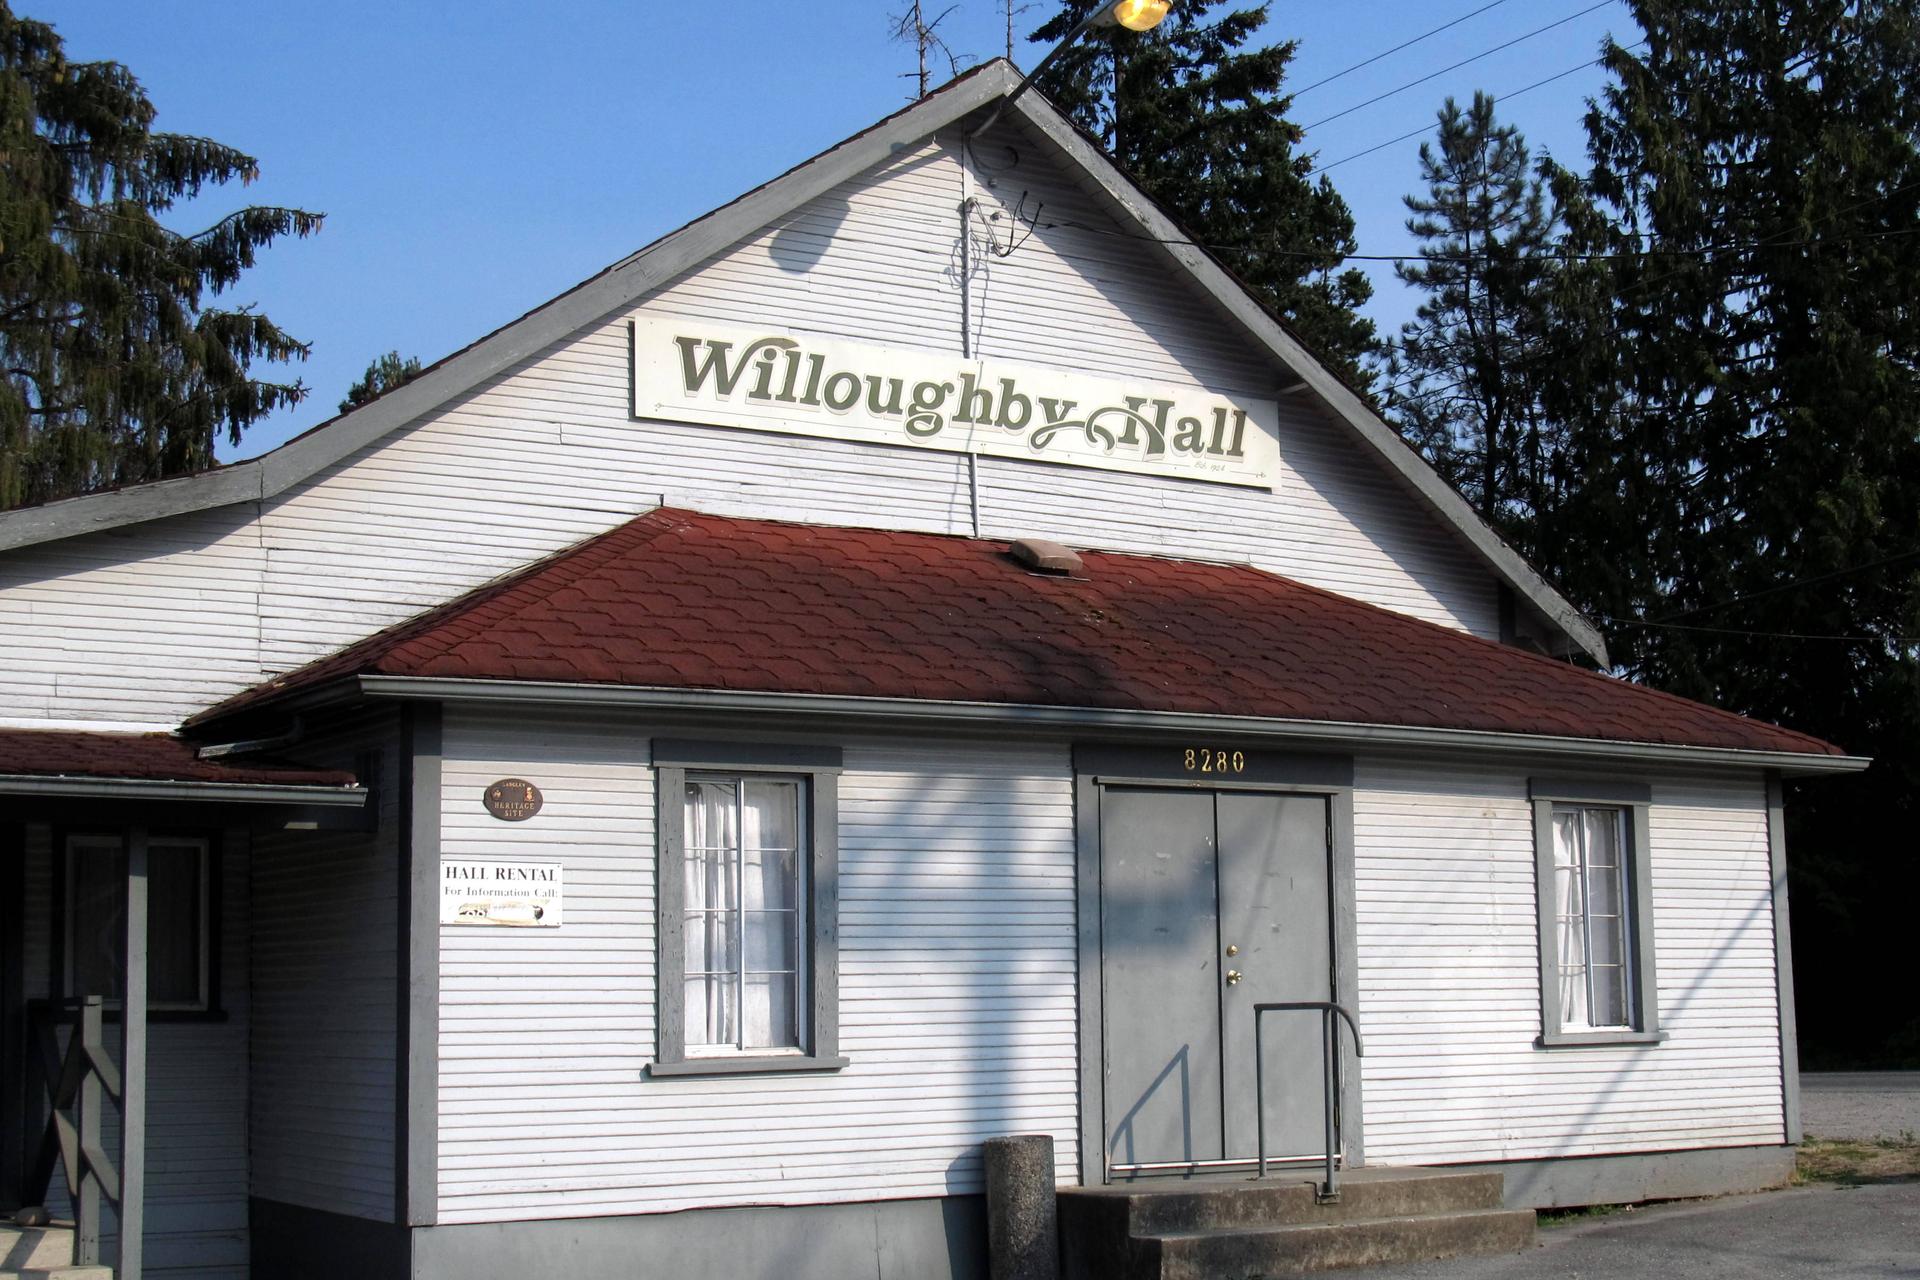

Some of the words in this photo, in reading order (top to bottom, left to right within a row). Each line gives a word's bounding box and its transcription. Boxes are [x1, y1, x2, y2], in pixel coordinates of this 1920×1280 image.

[673, 335, 1115, 452] Willoughby
[1084, 395, 1247, 455] Hall
[1184, 748, 1244, 773] 8280
[494, 801, 535, 810] HERITAGE
[504, 809, 524, 817] SITE
[446, 866, 489, 880] HALL
[495, 867, 558, 882] RENTAL
[444, 886, 462, 896] For
[467, 886, 530, 897] Information
[534, 888, 558, 898] Call:
